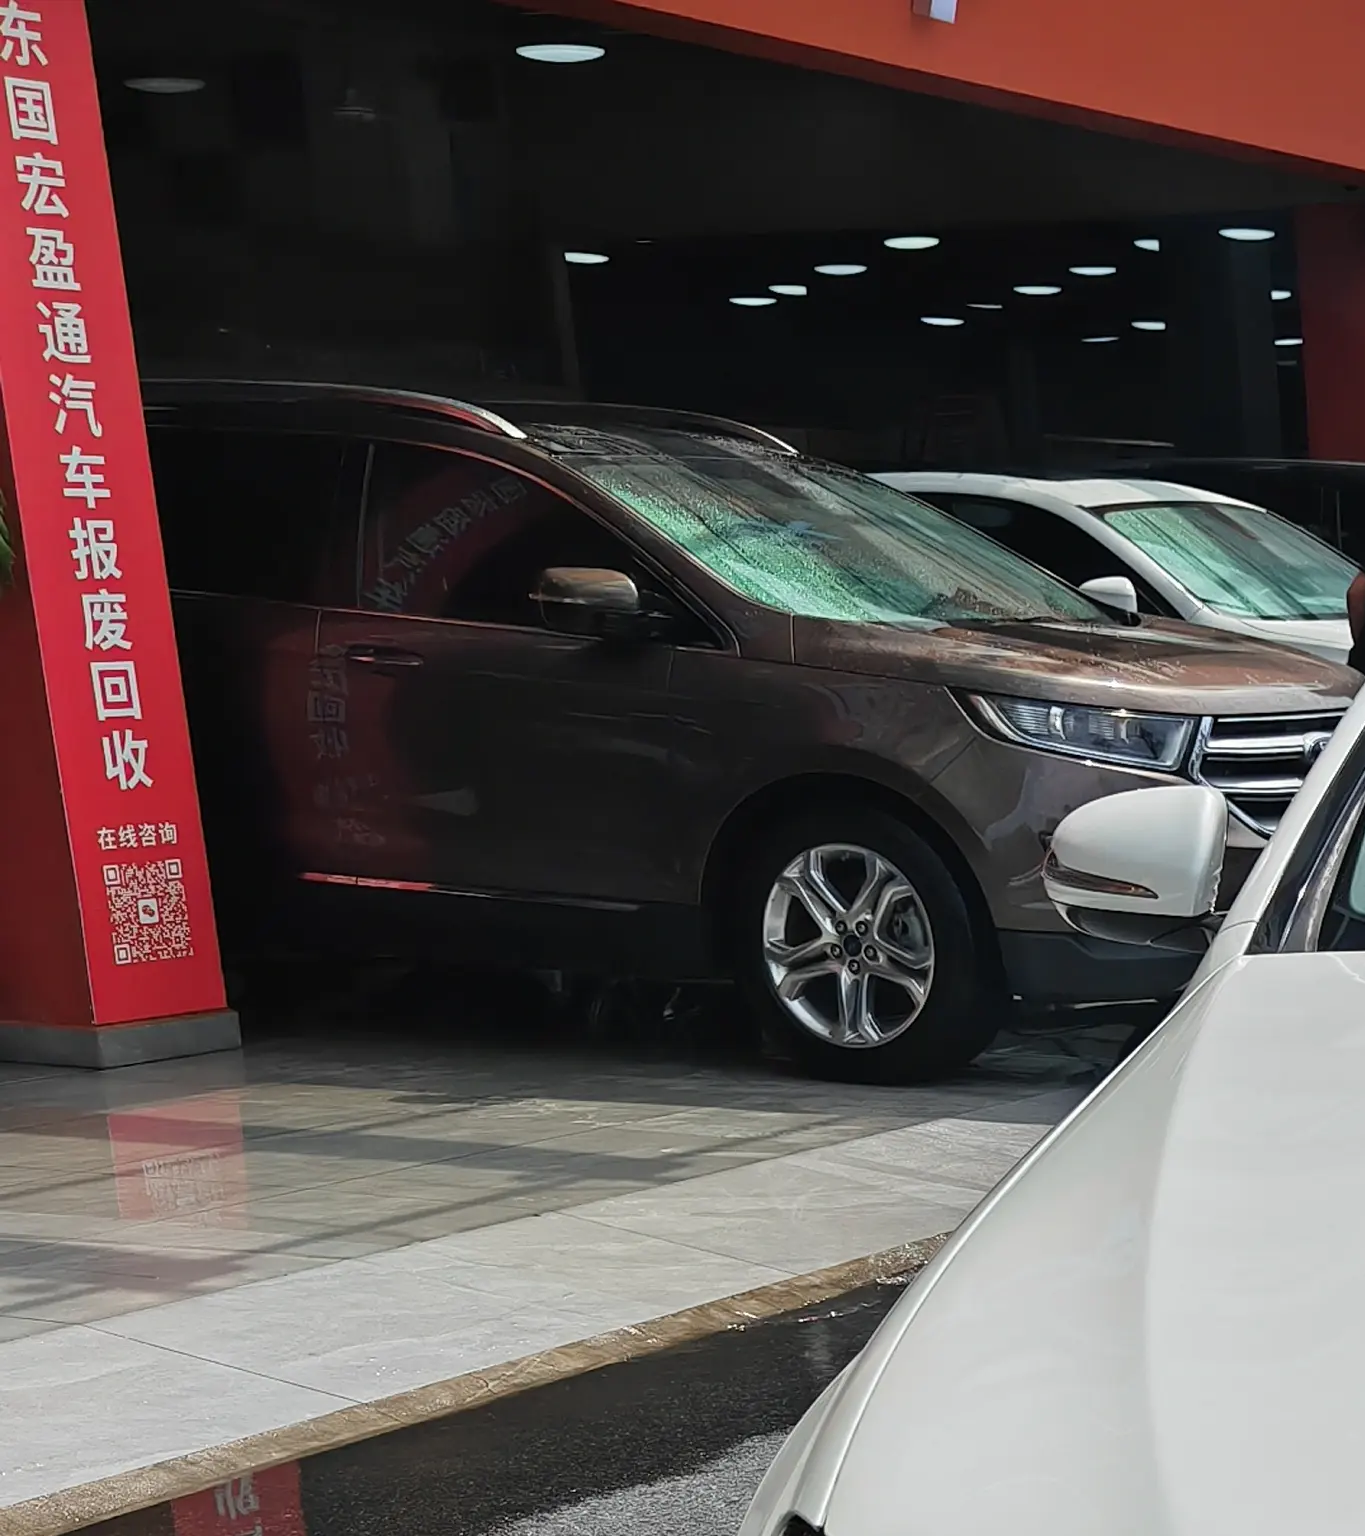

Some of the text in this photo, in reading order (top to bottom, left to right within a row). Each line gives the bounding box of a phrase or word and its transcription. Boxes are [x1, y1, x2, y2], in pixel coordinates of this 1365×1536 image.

[0, 0, 154, 792] 东国宏盈通汽车报废回收
[96, 821, 178, 850] 在线咨询
